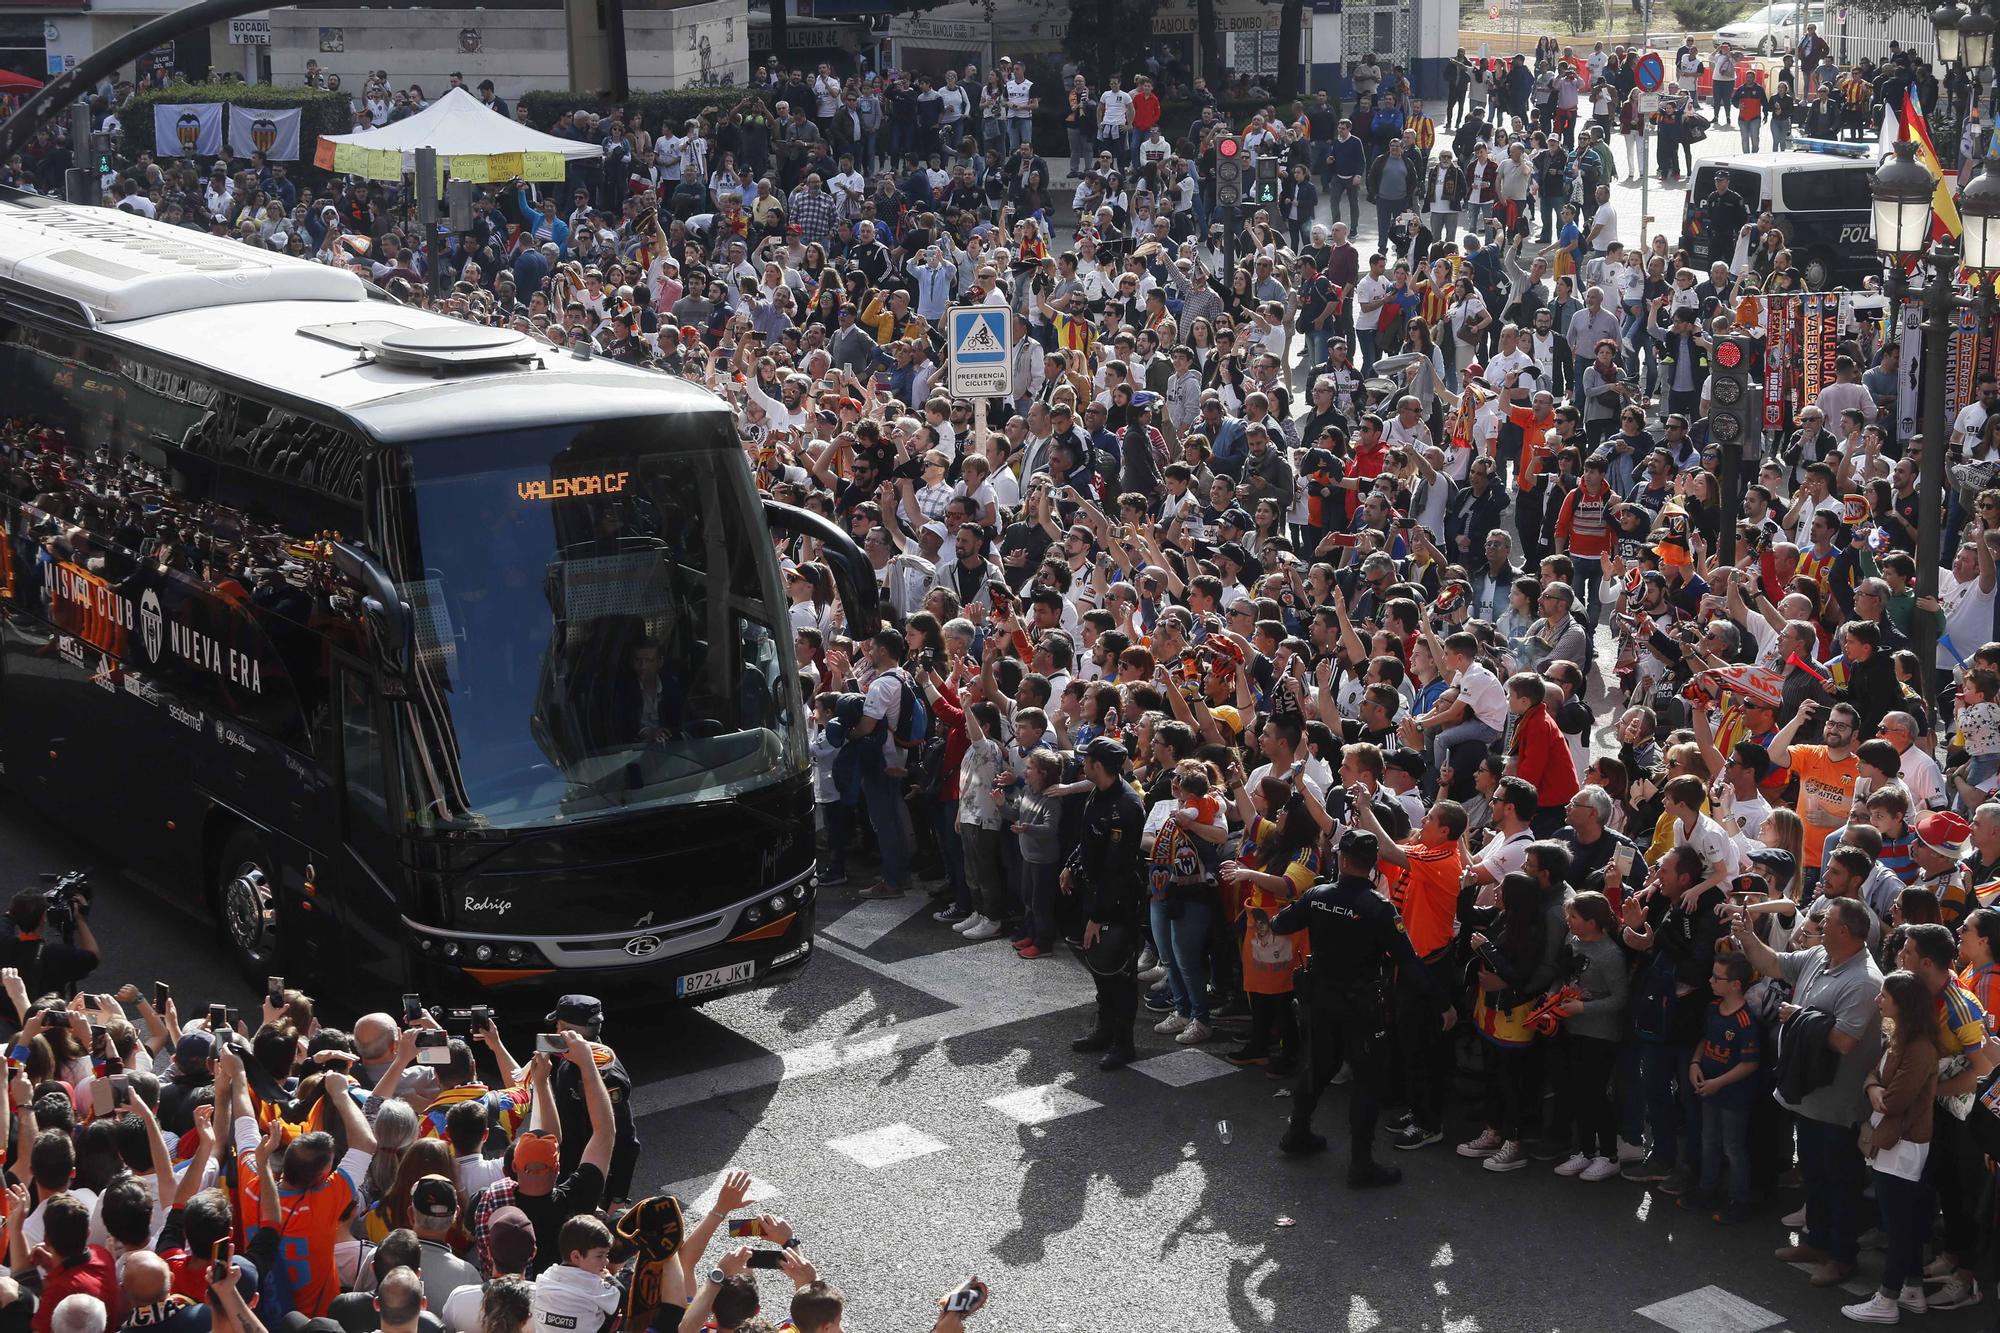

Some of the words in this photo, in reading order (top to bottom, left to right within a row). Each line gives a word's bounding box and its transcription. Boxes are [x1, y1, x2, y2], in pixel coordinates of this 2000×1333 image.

[1230, 15, 1262, 30] BOMBO
[235, 34, 242, 43] Y
[243, 34, 266, 44] BOTE
[787, 31, 824, 48] LLEVAR
[1839, 227, 1870, 244] POL
[1771, 311, 1780, 347] ESPAÑA
[1807, 314, 1818, 387] VALENCIA
[1823, 315, 1837, 384] VALENCIA
[957, 372, 1005, 380] PREFERENCIA
[1945, 337, 1958, 396] VALENCIA
[1958, 337, 1974, 398] VALENCIA
[1769, 372, 1779, 402] NORGE
[1945, 400, 1955, 413] CF
[517, 475, 602, 501] VALENCIA
[604, 471, 629, 493] CF
[44, 560, 92, 610] MISMO
[97, 586, 134, 631] CLUB
[170, 620, 222, 675] NUEVA
[229, 648, 261, 694] ERA
[464, 896, 512, 915] Rodrigo
[1310, 900, 1356, 917] POLICIA
[687, 971, 721, 991] 8724
[726, 962, 751, 982] JKW
[546, 1314, 575, 1328] SPORTS
